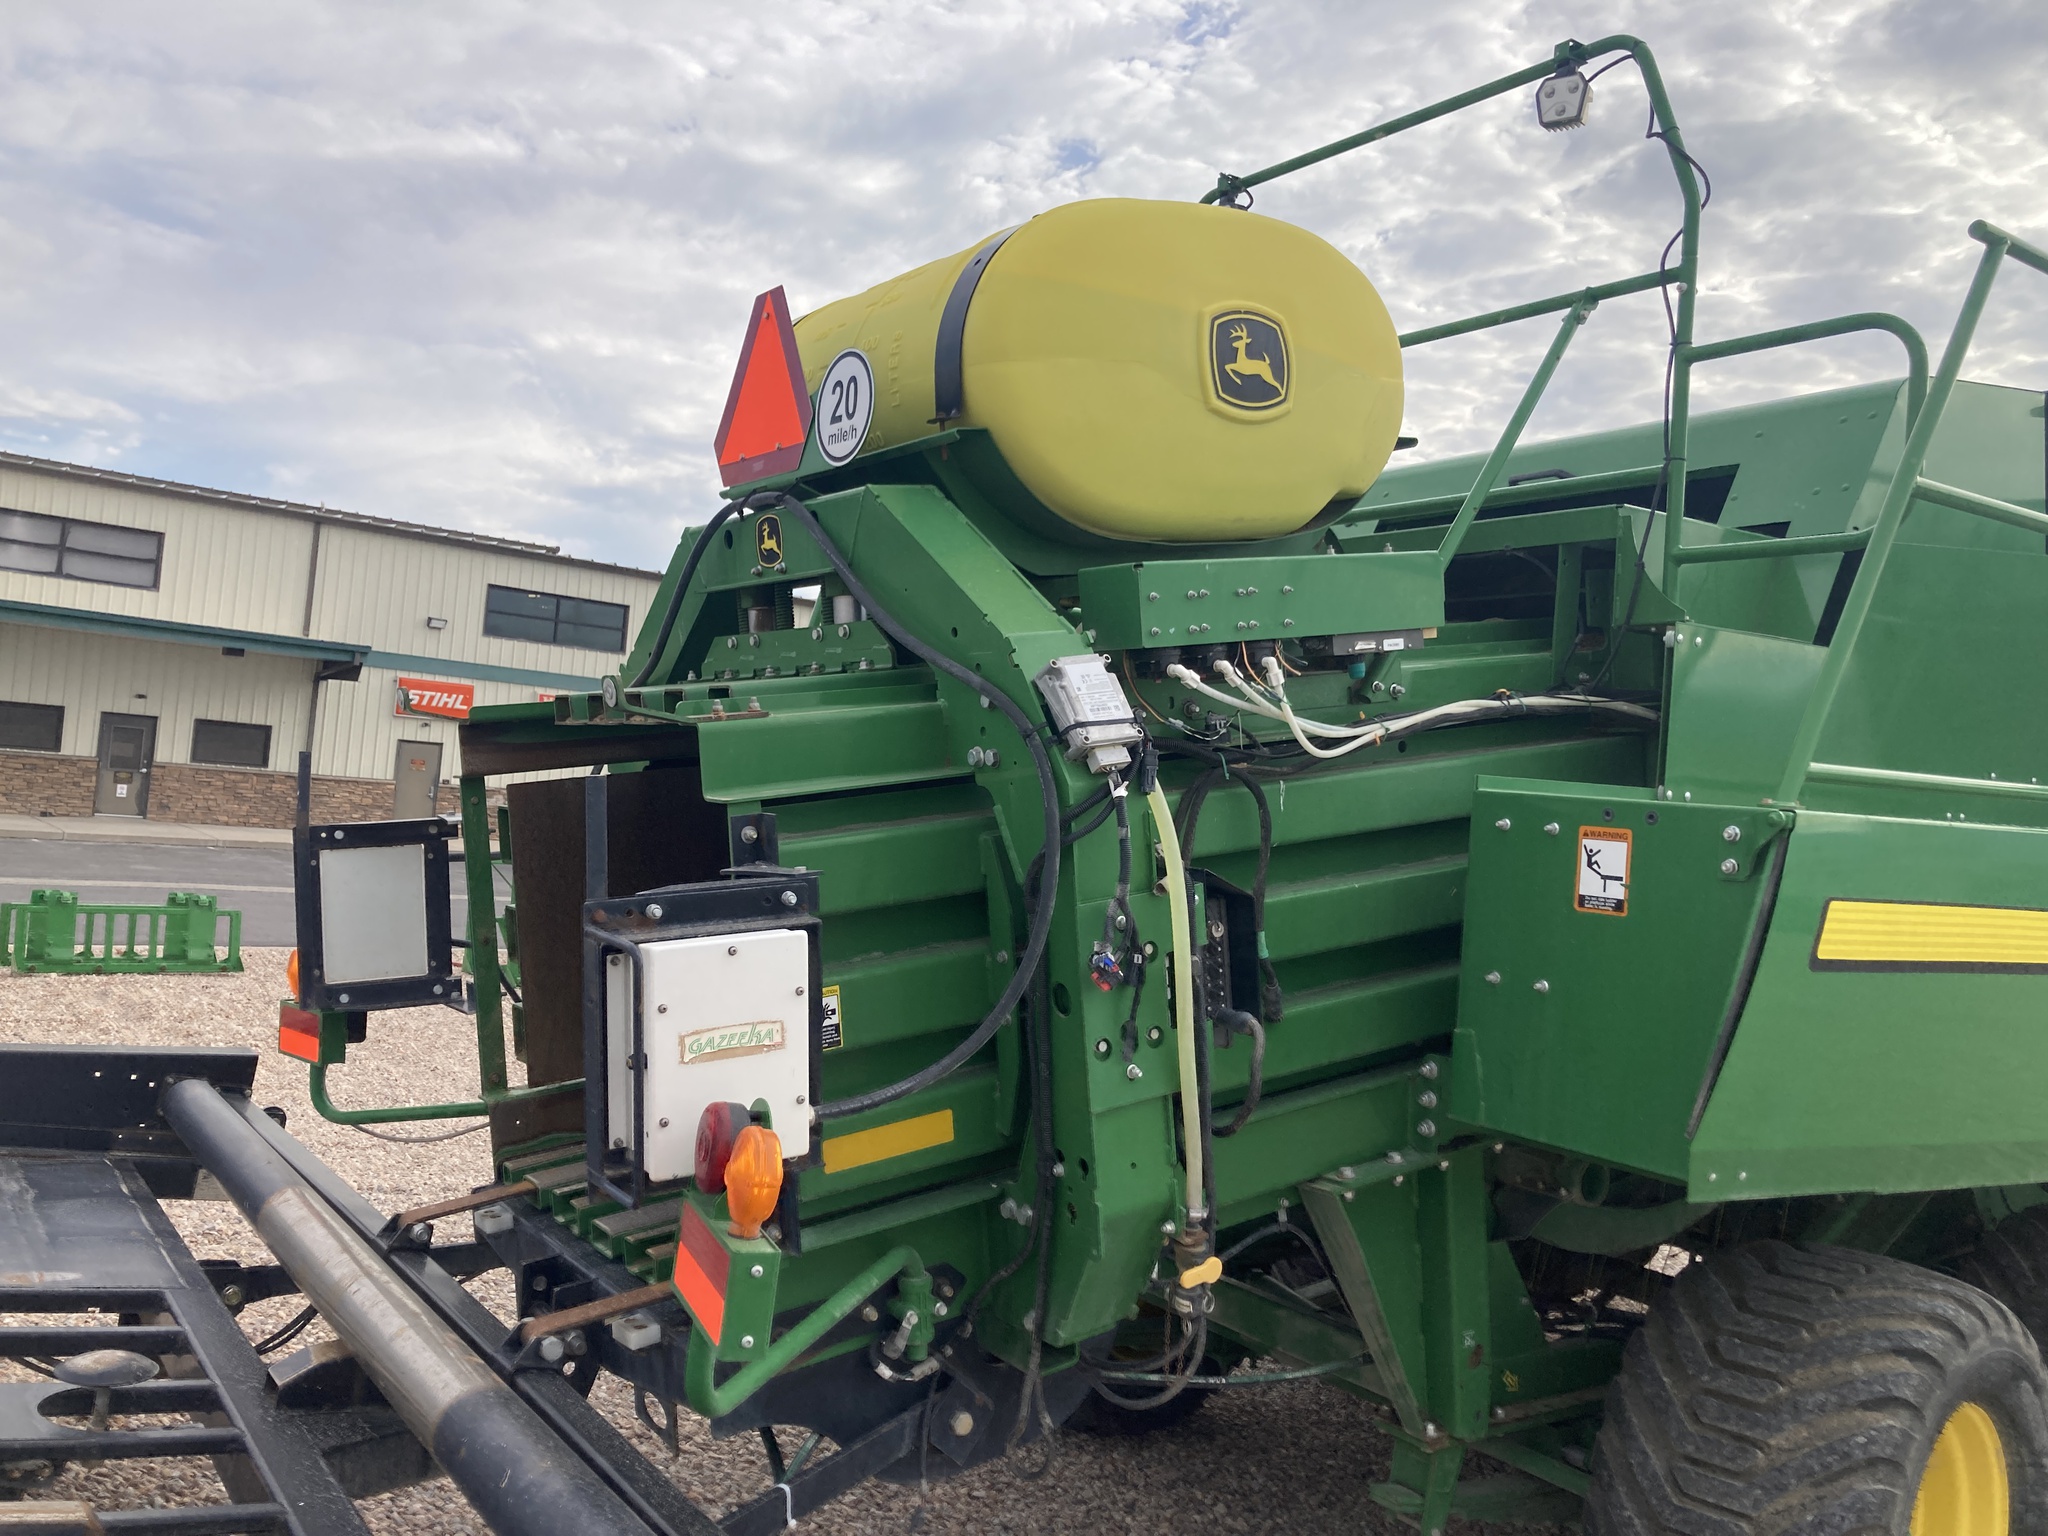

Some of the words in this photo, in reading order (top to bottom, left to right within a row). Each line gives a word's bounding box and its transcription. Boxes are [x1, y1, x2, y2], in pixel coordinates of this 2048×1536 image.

[830, 375, 858, 425] 20
[827, 426, 857, 446] mile/h
[408, 689, 468, 710] STIHL
[1590, 830, 1629, 840] WARNING
